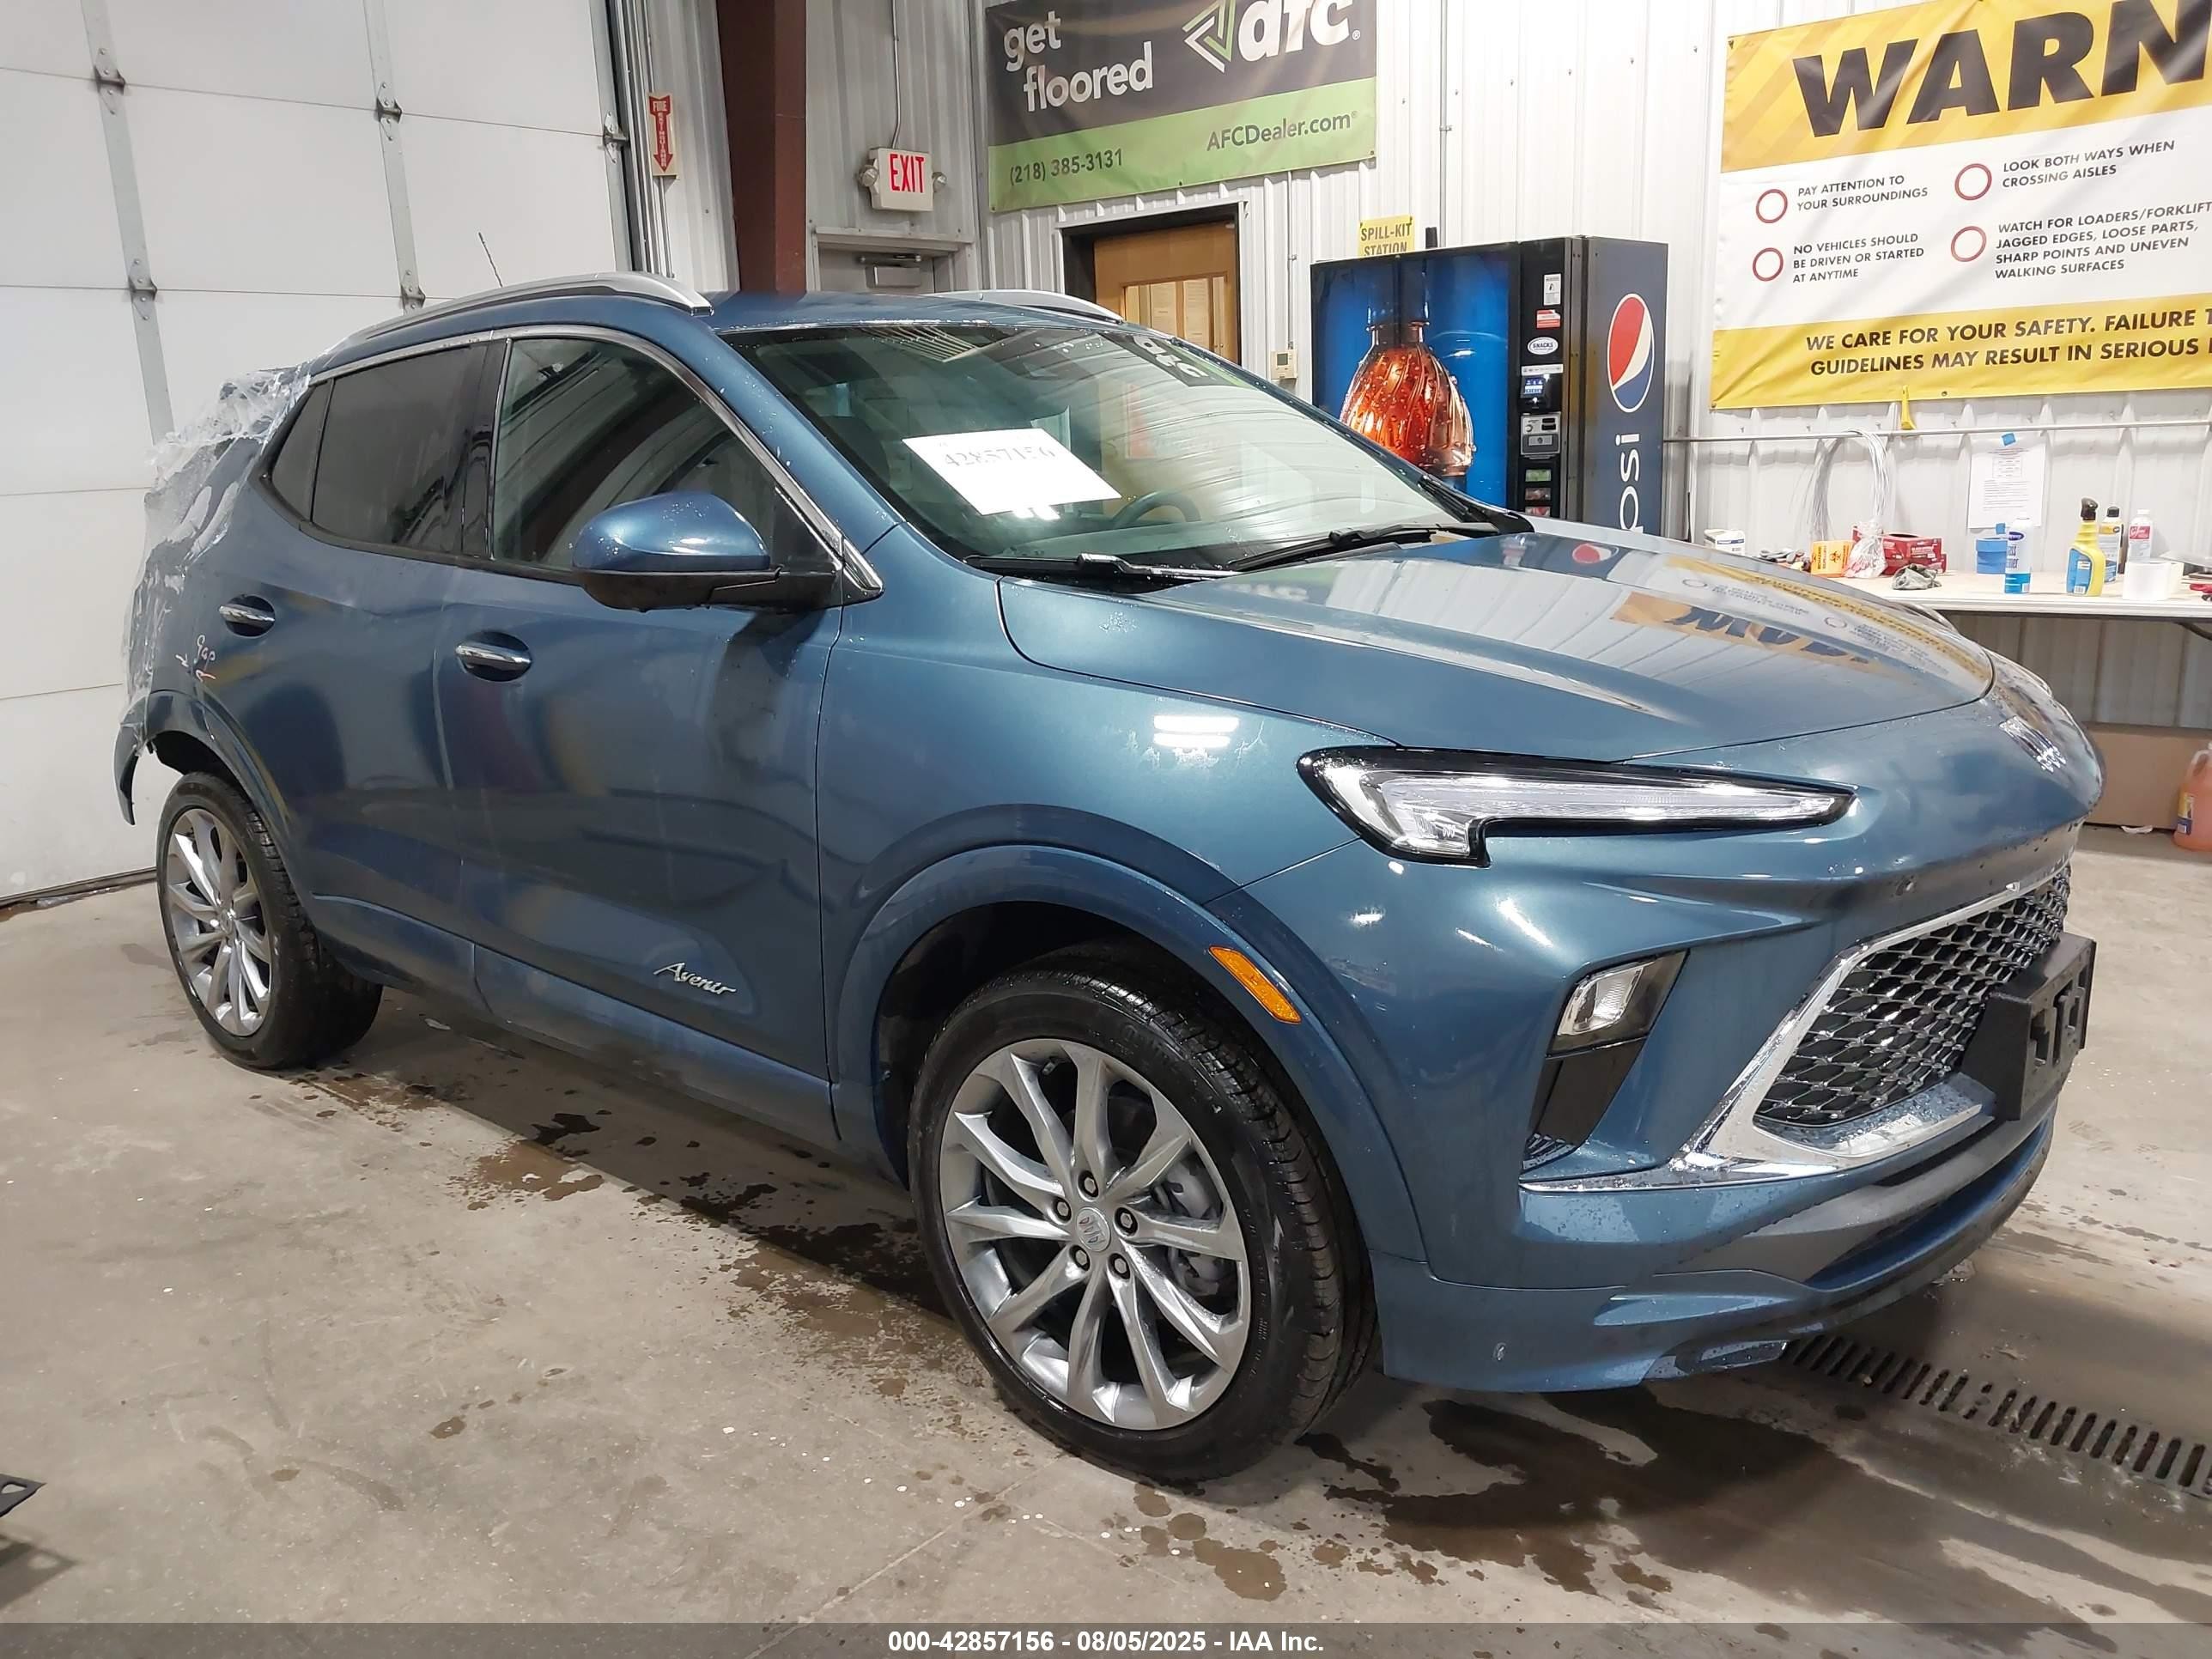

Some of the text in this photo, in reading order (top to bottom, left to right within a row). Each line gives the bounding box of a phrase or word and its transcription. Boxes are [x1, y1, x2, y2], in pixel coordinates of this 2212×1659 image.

[1004, 10, 1061, 71] get
[1238, 0, 1352, 62] afc
[1024, 41, 1153, 112] floored
[1793, 0, 2212, 137] WARN
[1010, 148, 1122, 185] (218) 385-3131
[2003, 140, 2175, 173] LOOK BOTH WAYS WHEN
[889, 153, 925, 193] EXIT
[1798, 175, 1905, 197] PAY ATTENTION TO
[2002, 165, 2117, 188] CROSSING AISLES
[1797, 187, 1928, 211] YOUR SURROUNDINGS
[1360, 223, 1413, 241] SPILL-KIT
[1996, 220, 2198, 249] JAGGED EDGES, LOOSE PARTS,
[1998, 220, 2043, 234] WATCH
[2047, 217, 2073, 229] FOR
[1364, 241, 1407, 256] STATION
[1793, 234, 1918, 254] NO VEHICLES SHOULD
[1793, 247, 1924, 269] BE DRIVEN OR STARTED
[1996, 237, 2189, 264] SHARP POINTS AND UNEVEN
[1793, 268, 1858, 283] AT ANYTIME
[1995, 259, 2125, 279] WALKING SURFACES
[1806, 335, 1835, 350] WE
[1841, 331, 1892, 349] CARE
[1899, 327, 1938, 344] FOR
[1946, 322, 2006, 341] YOUR
[2014, 316, 2095, 337] SAFETY.
[2104, 309, 2197, 331] FAILURE
[1811, 354, 1924, 375] GUIDELINES
[1931, 350, 1979, 368] MAY
[1984, 346, 2060, 366] RESULT
[2067, 344, 2092, 362] IN
[2100, 337, 2199, 360] SERIOUS
[653, 962, 737, 994] Avenir
